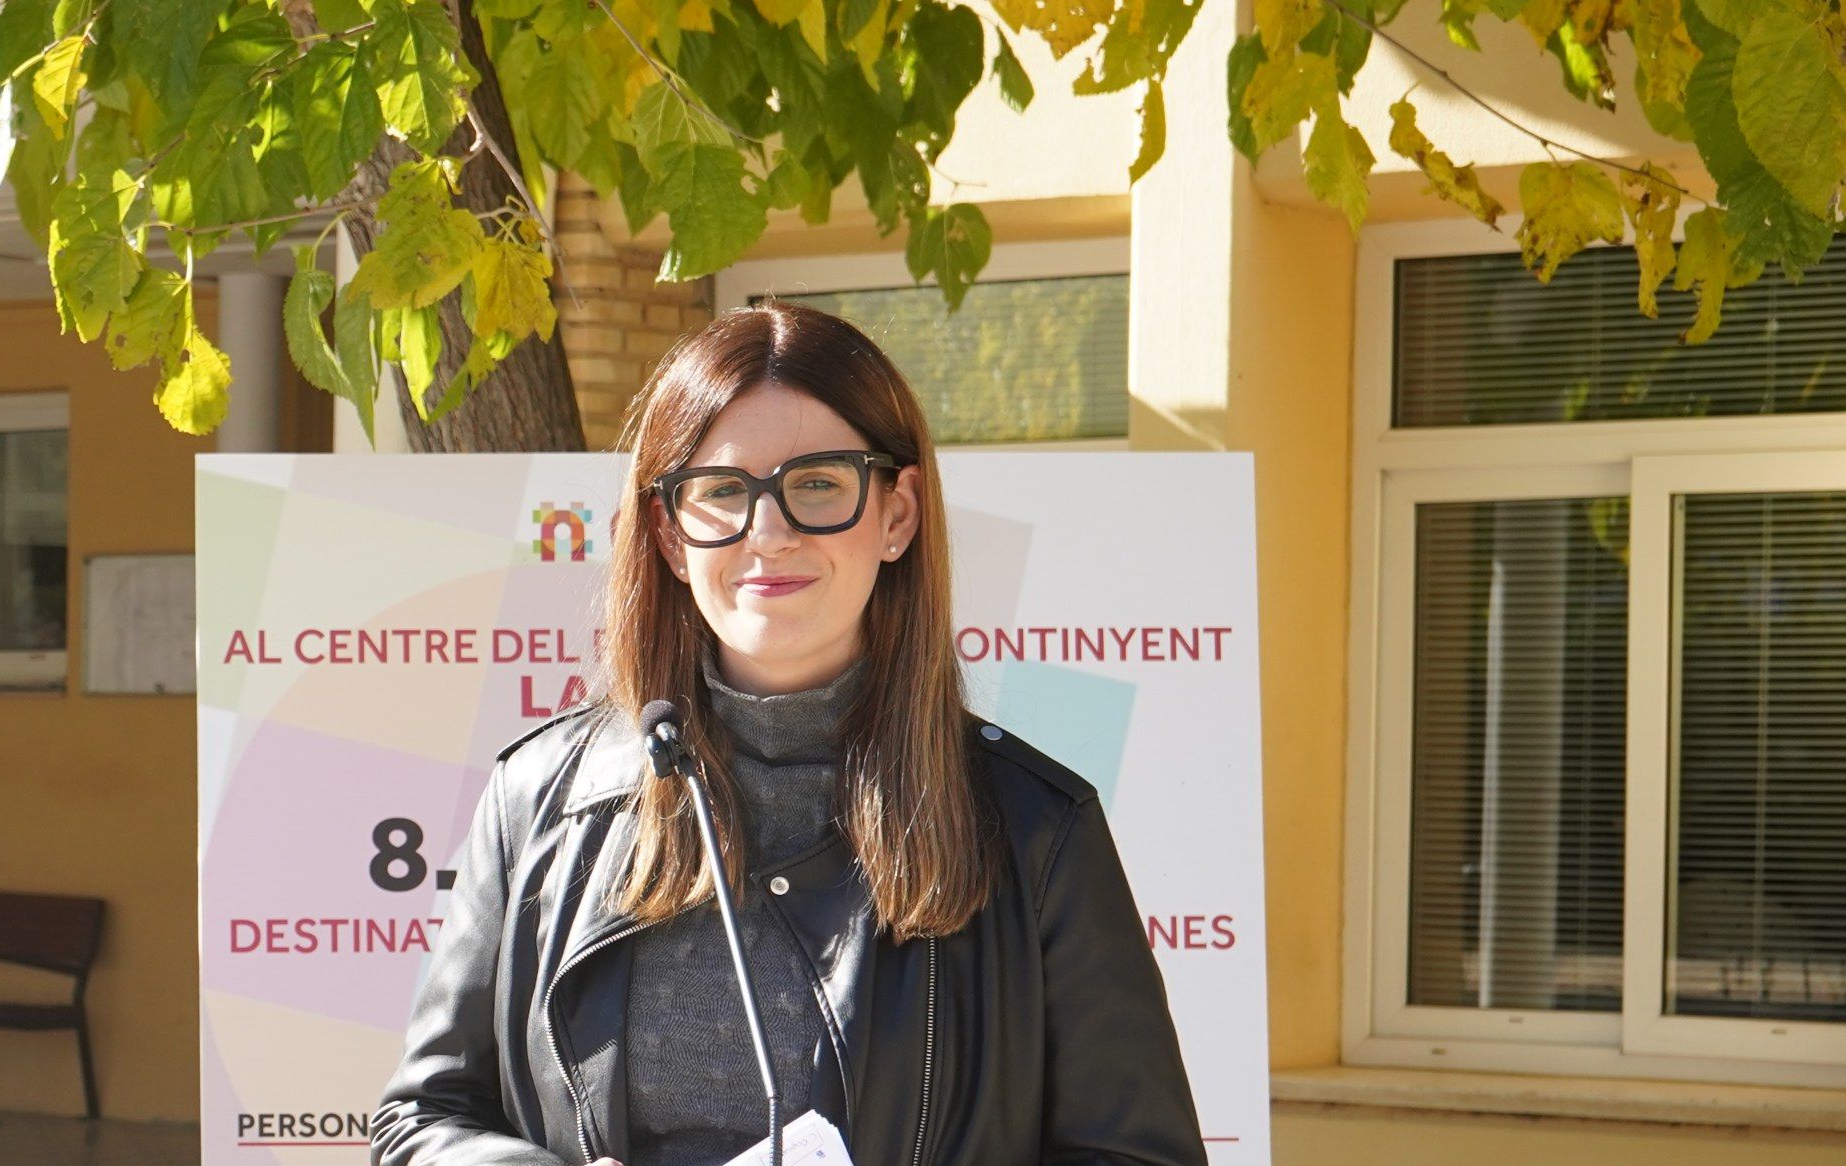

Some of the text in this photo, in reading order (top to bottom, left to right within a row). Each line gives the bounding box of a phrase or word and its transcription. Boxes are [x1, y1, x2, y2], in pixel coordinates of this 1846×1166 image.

[224, 630, 282, 664] AL
[294, 630, 478, 664] CENTRE
[492, 629, 580, 664] DEL
